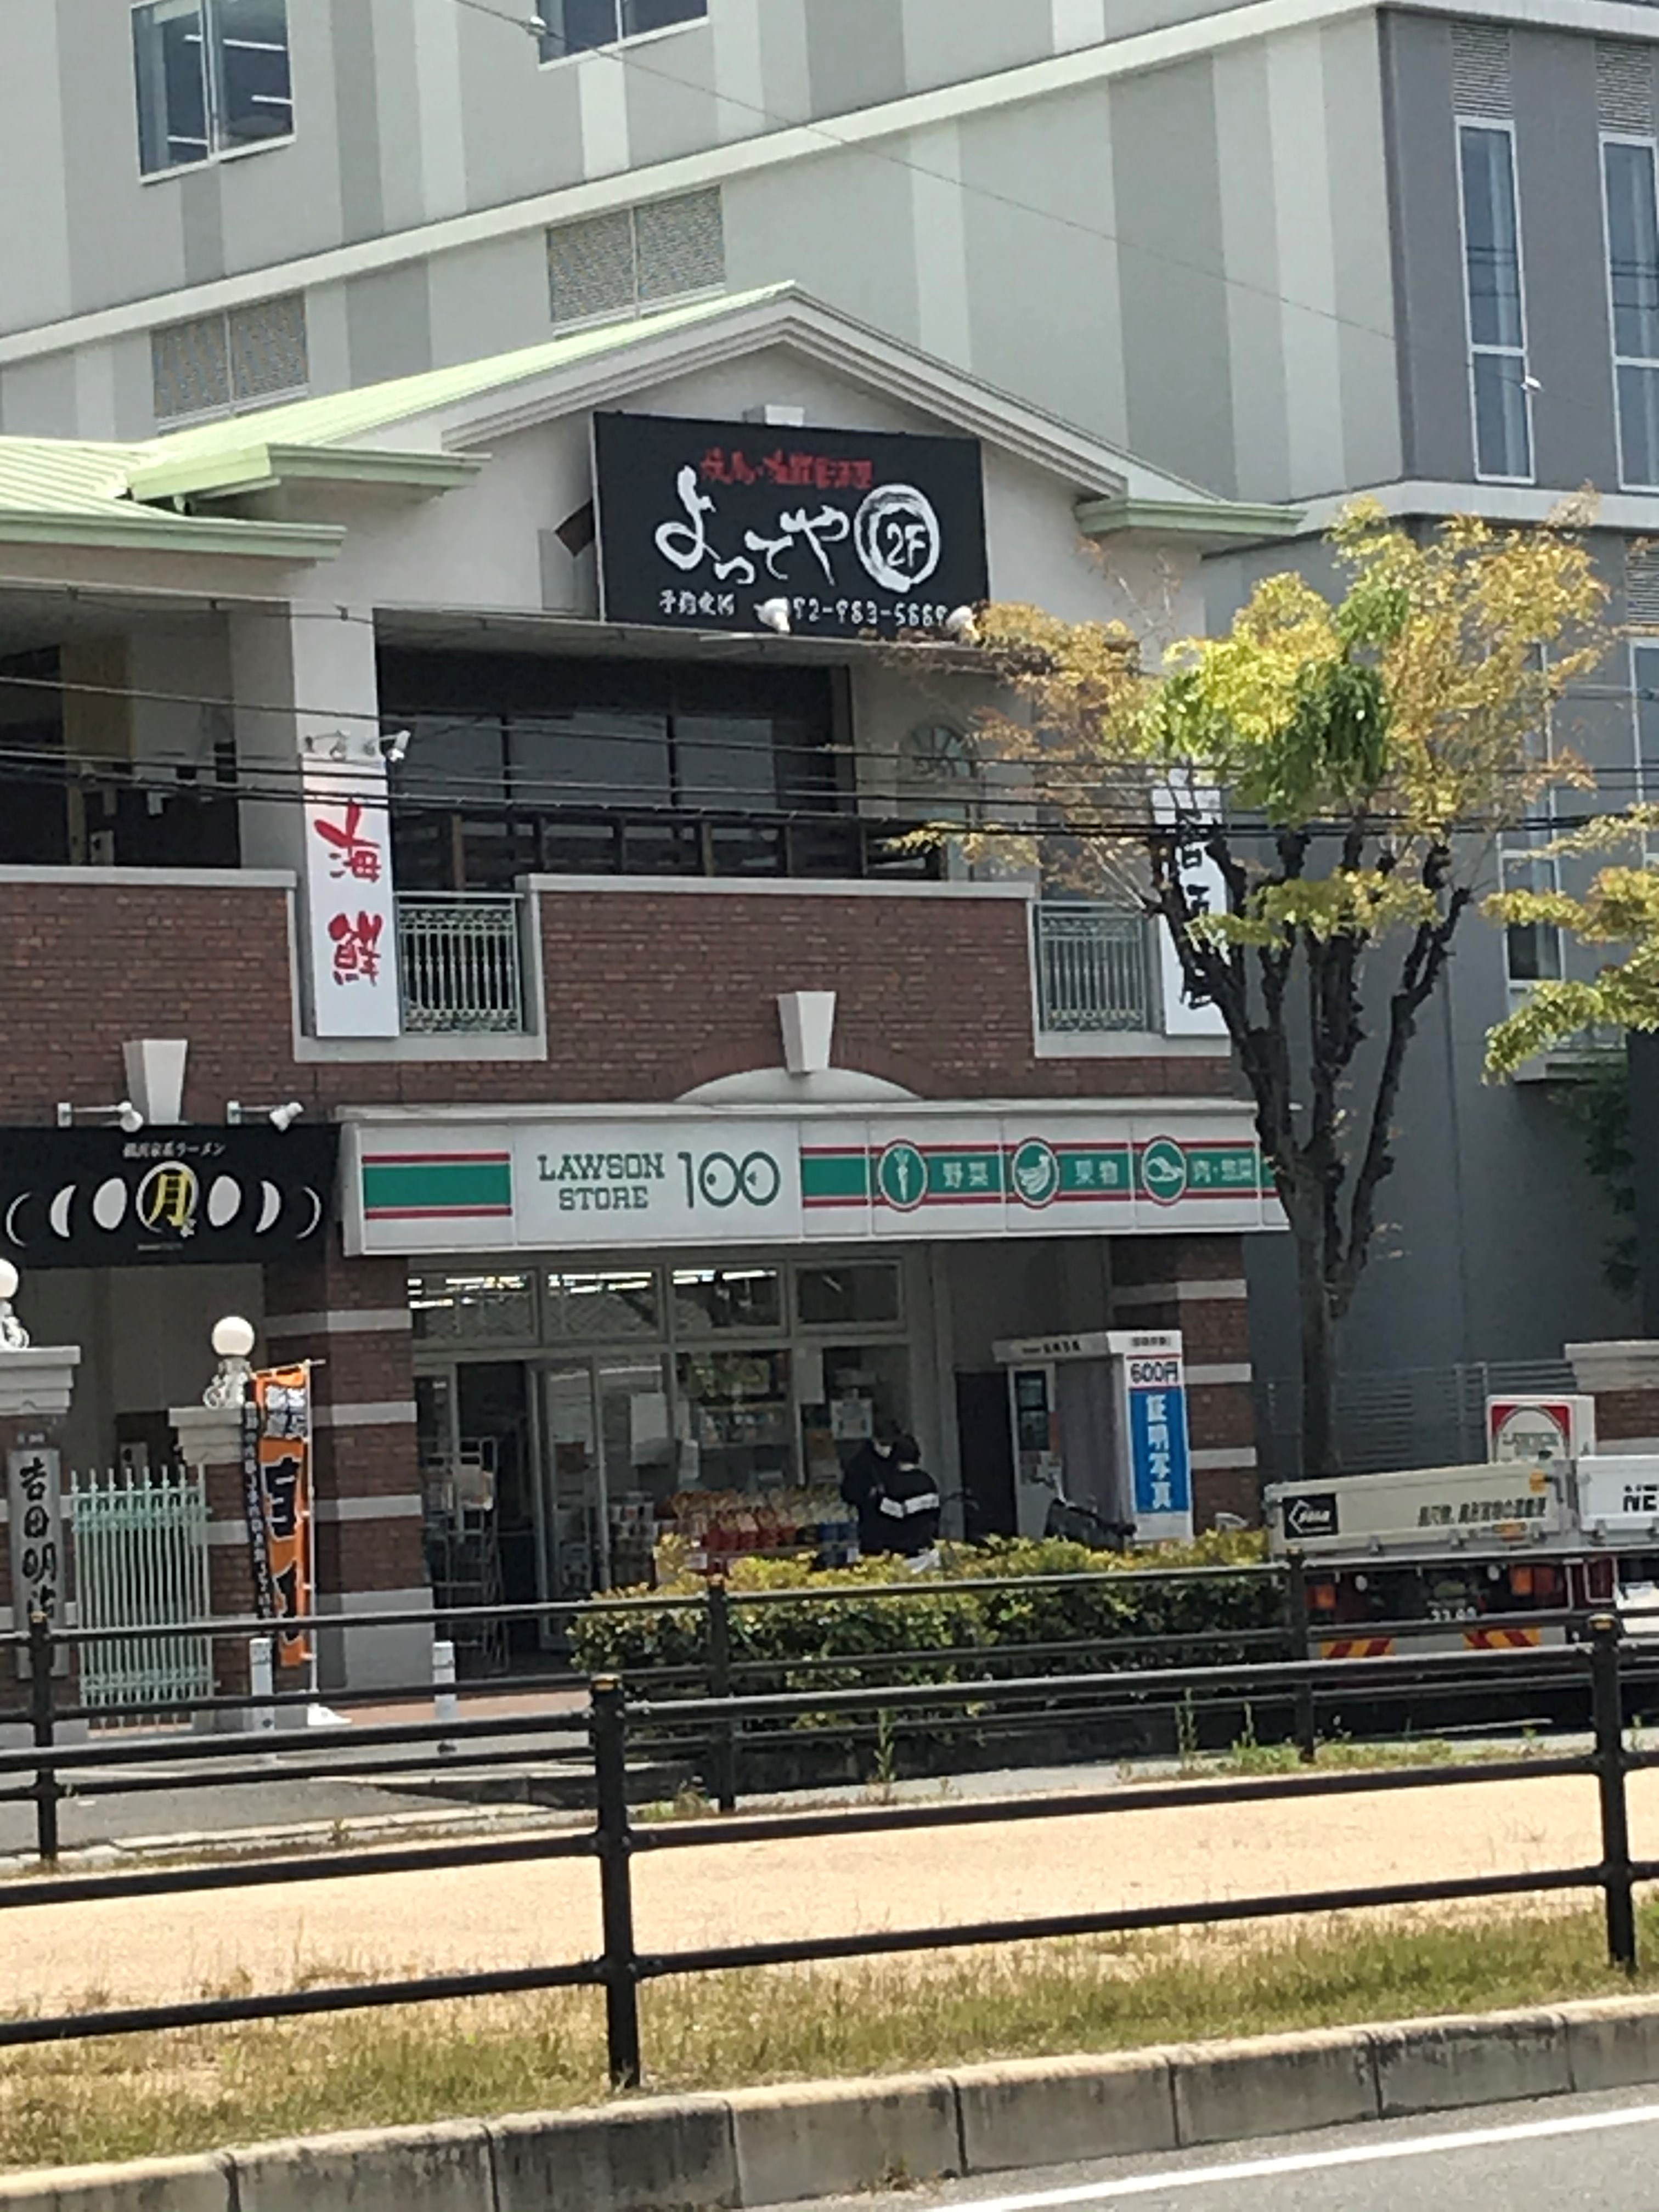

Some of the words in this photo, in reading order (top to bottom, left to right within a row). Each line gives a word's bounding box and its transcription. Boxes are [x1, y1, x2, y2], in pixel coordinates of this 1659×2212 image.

[887, 522, 927, 568] 2F
[537, 1153, 665, 1181] LAWSON
[678, 1151, 781, 1209] 100
[942, 1162, 988, 1188] 野菜
[1074, 1159, 1118, 1185] 果物
[558, 1186, 648, 1211] STORE
[1130, 1361, 1179, 1384] 600円
